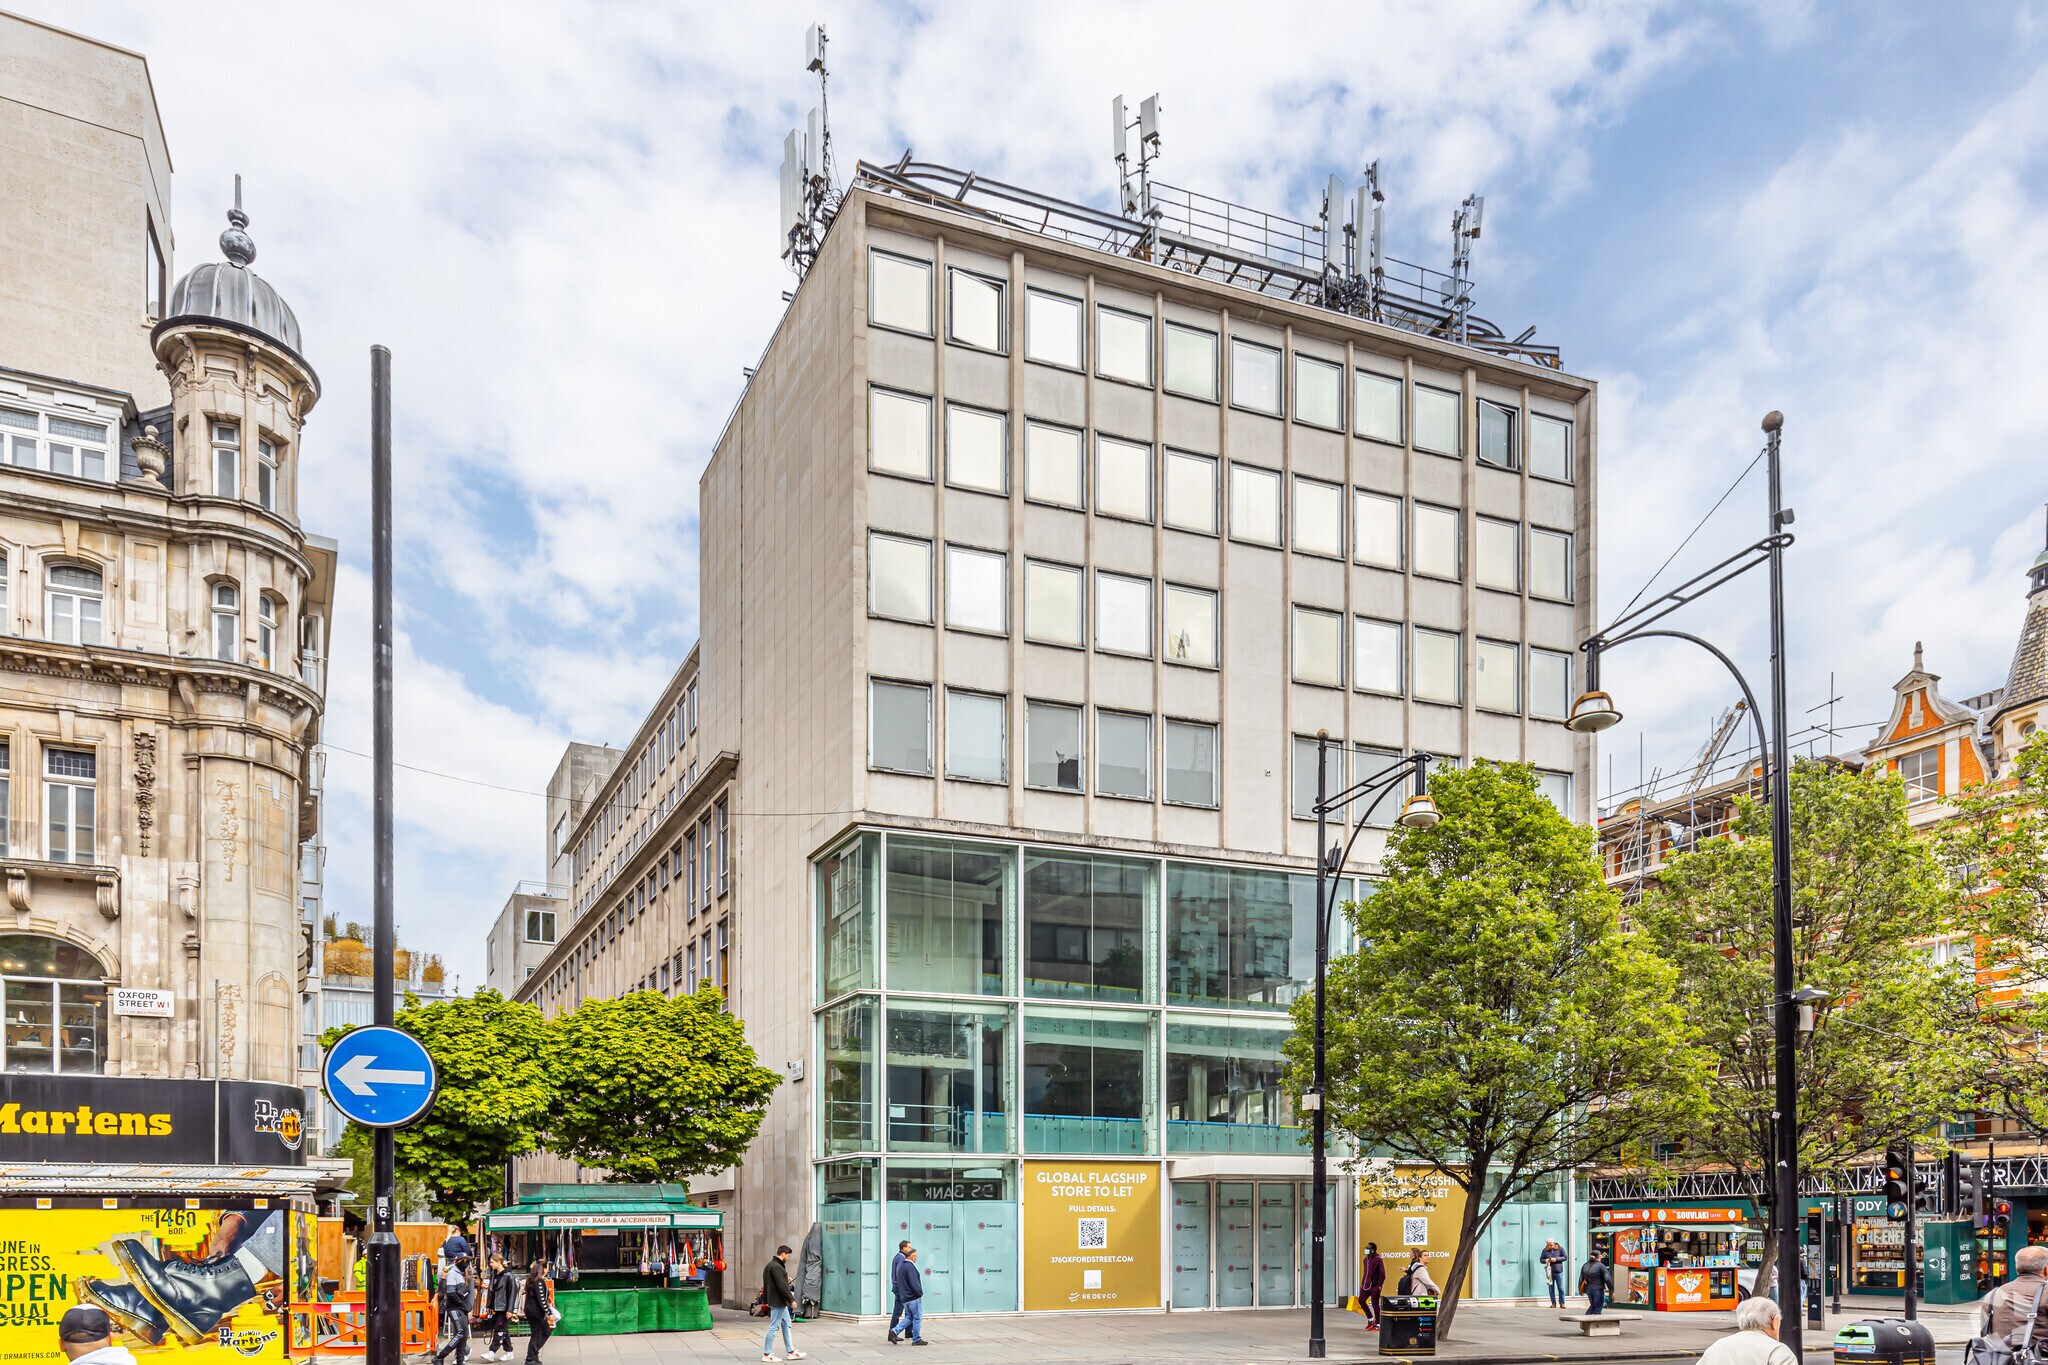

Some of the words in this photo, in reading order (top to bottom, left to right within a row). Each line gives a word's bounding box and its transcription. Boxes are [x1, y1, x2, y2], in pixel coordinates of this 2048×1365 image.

[118, 992, 158, 1000] OXFORD
[0, 1103, 173, 1136] Martens
[1037, 1172, 1086, 1183] GLOBAL
[1088, 1173, 1147, 1184] FLAGSHIP
[1052, 1186, 1091, 1197] STORE
[1094, 1186, 1110, 1197] TO
[1113, 1186, 1133, 1197] LET
[1433, 1189, 1449, 1198] LET
[1854, 1201, 1882, 1212] ODY
[154, 1209, 196, 1228] 1460
[30, 1244, 40, 1253] IN
[219, 1331, 278, 1347] Martens
